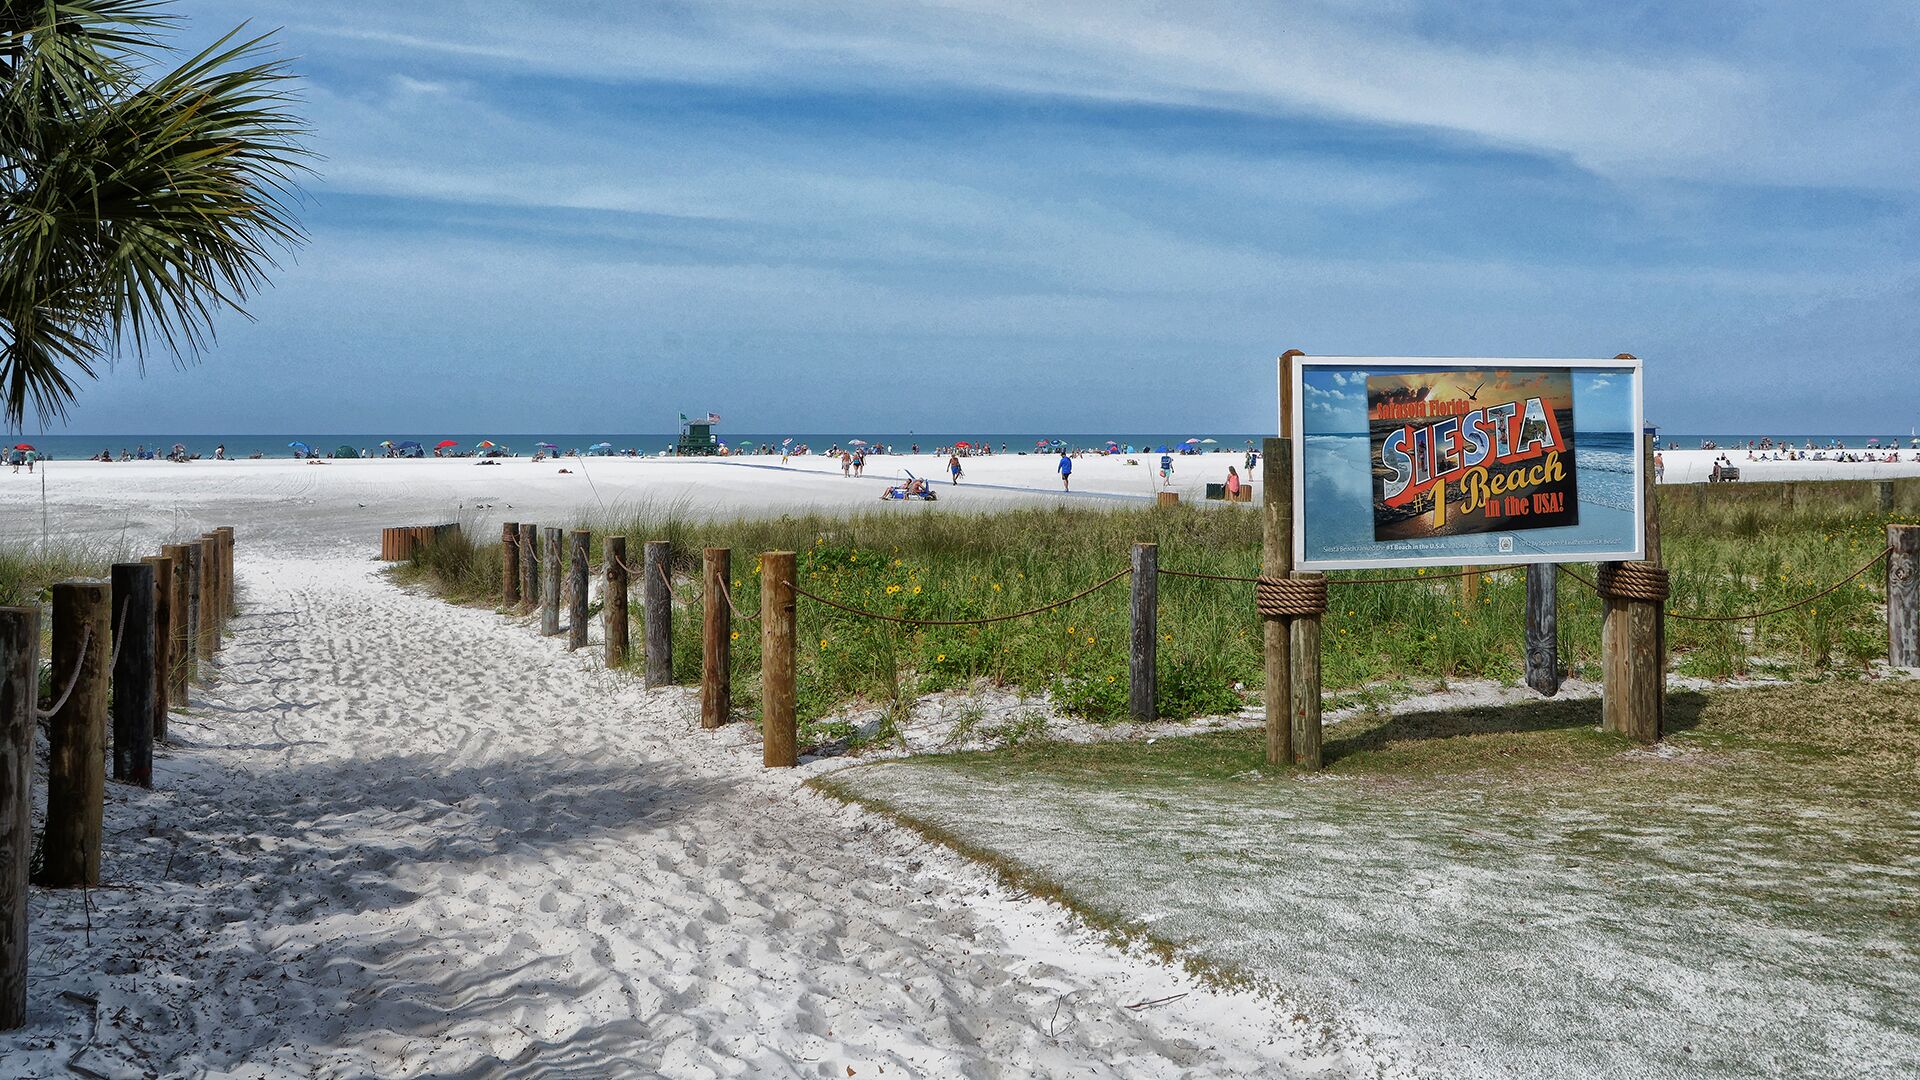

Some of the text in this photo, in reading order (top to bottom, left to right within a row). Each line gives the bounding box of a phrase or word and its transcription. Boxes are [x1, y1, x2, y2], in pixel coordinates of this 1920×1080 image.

[1377, 399, 1471, 420] Sarasota Florida
[1382, 397, 1556, 501] SIESTA
[1413, 478, 1446, 529] #1
[1460, 450, 1567, 514] Beach
[1484, 492, 1565, 518] in the USA!
